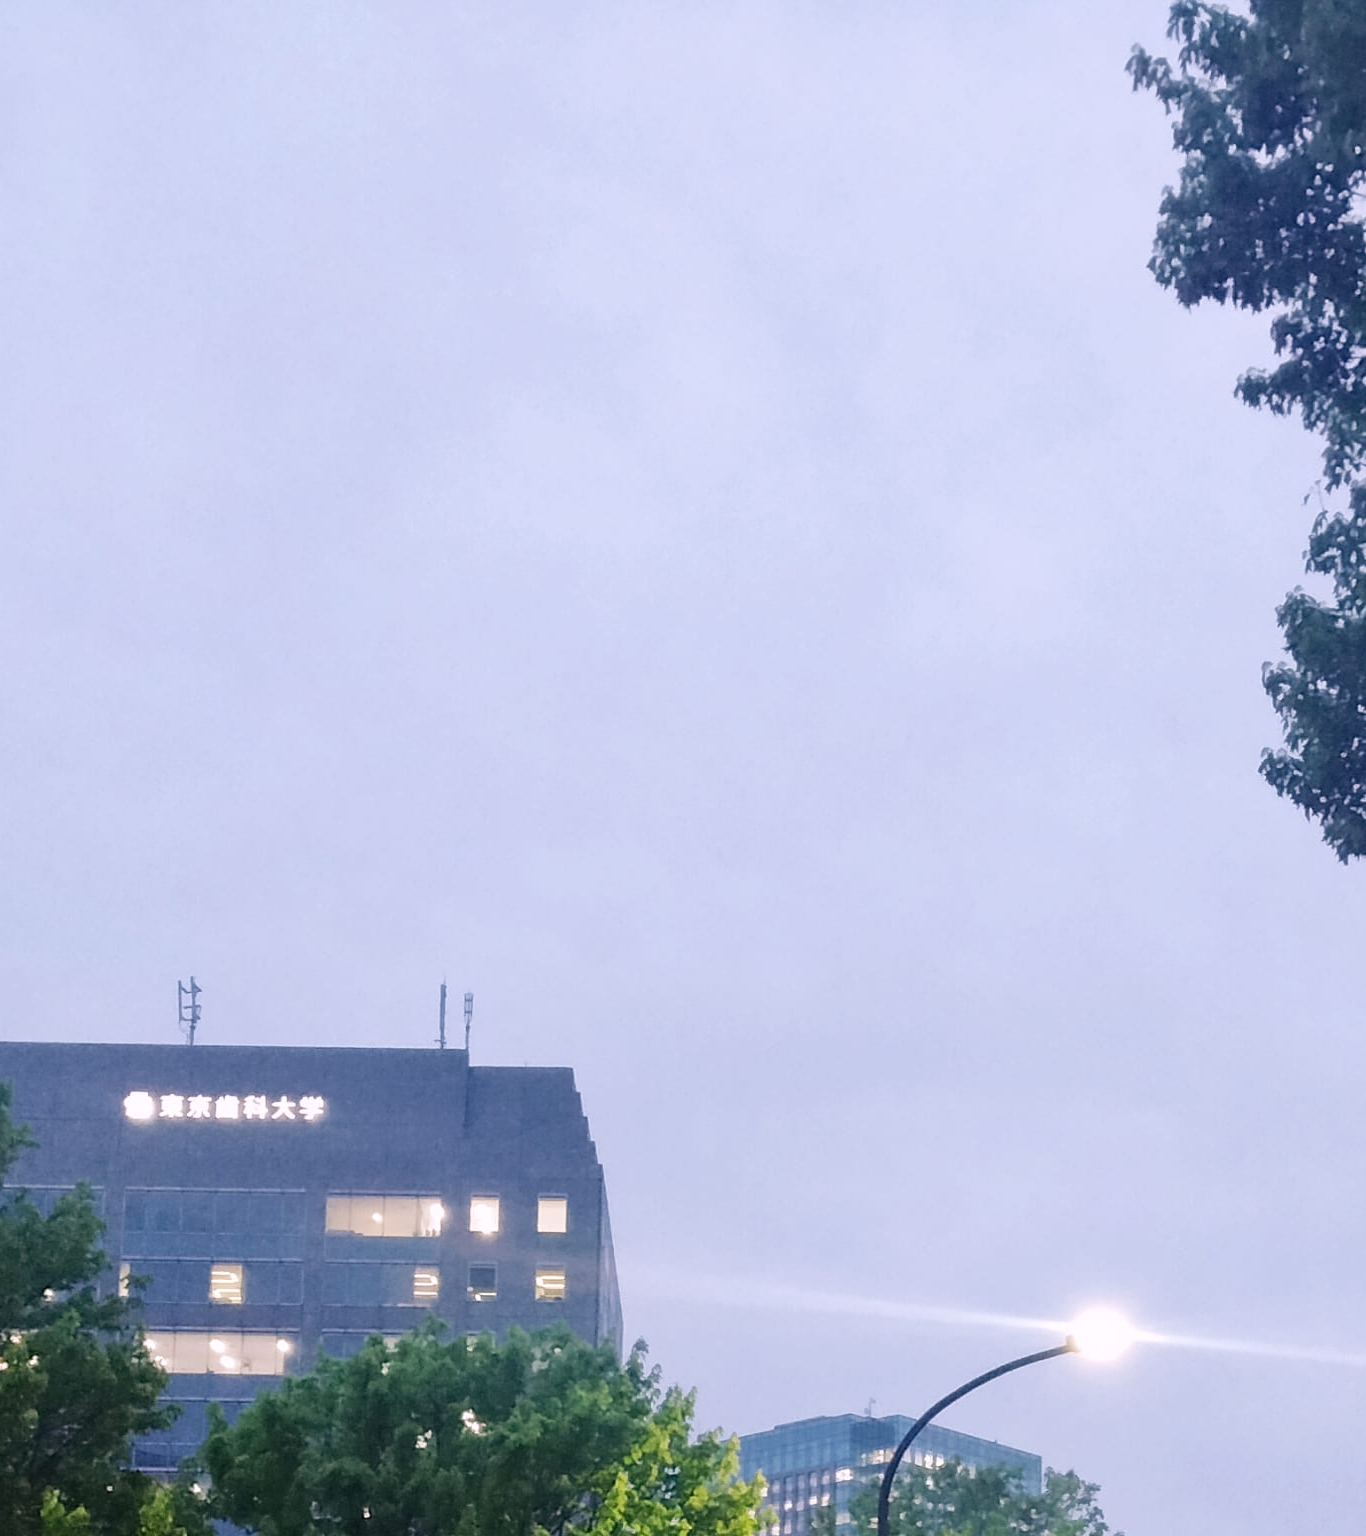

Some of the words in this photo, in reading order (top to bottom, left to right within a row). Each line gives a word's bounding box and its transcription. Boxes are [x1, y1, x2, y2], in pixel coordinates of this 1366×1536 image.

[159, 1093, 325, 1121] 東京歯科大学
